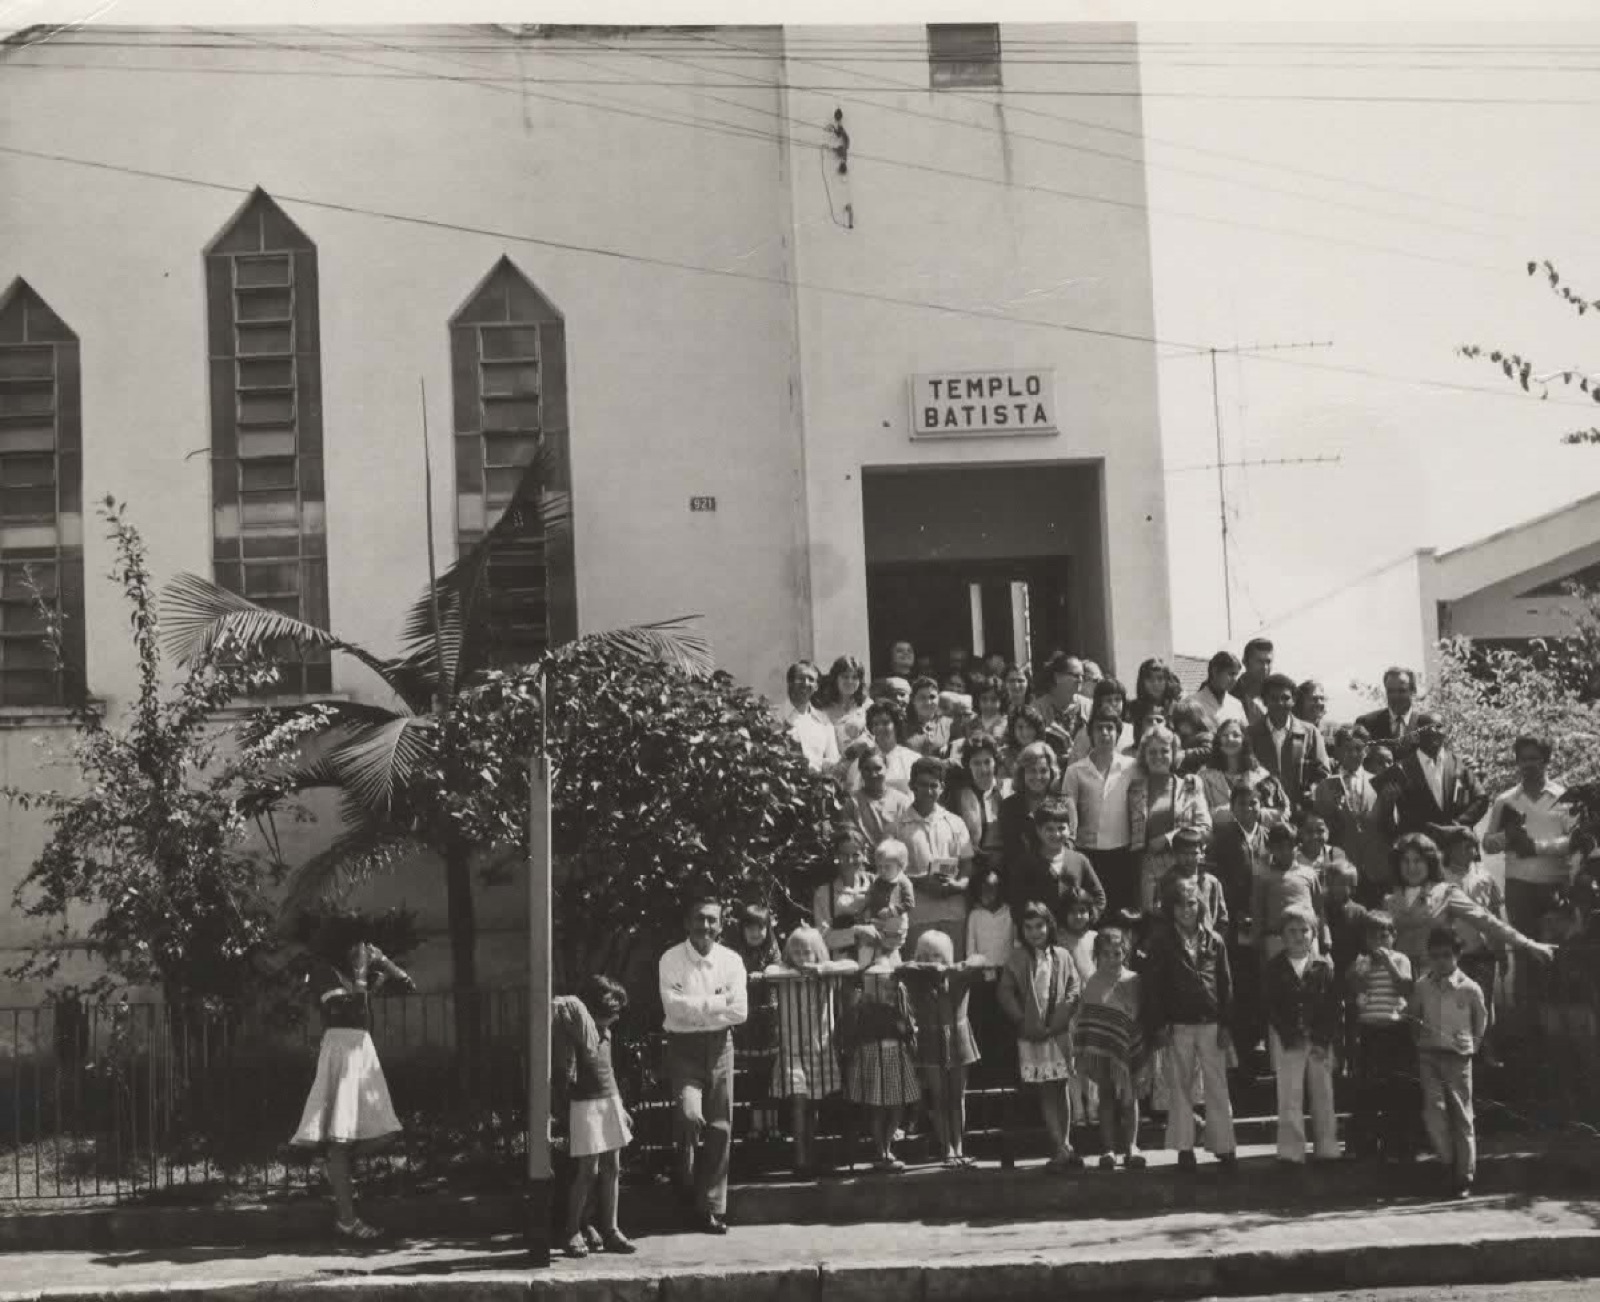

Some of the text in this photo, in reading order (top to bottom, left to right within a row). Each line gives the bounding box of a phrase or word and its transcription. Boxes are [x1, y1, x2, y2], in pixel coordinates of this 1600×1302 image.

[929, 375, 1040, 400] TEMPLO
[925, 403, 1047, 428] BATISTA
[693, 498, 712, 509] 921
